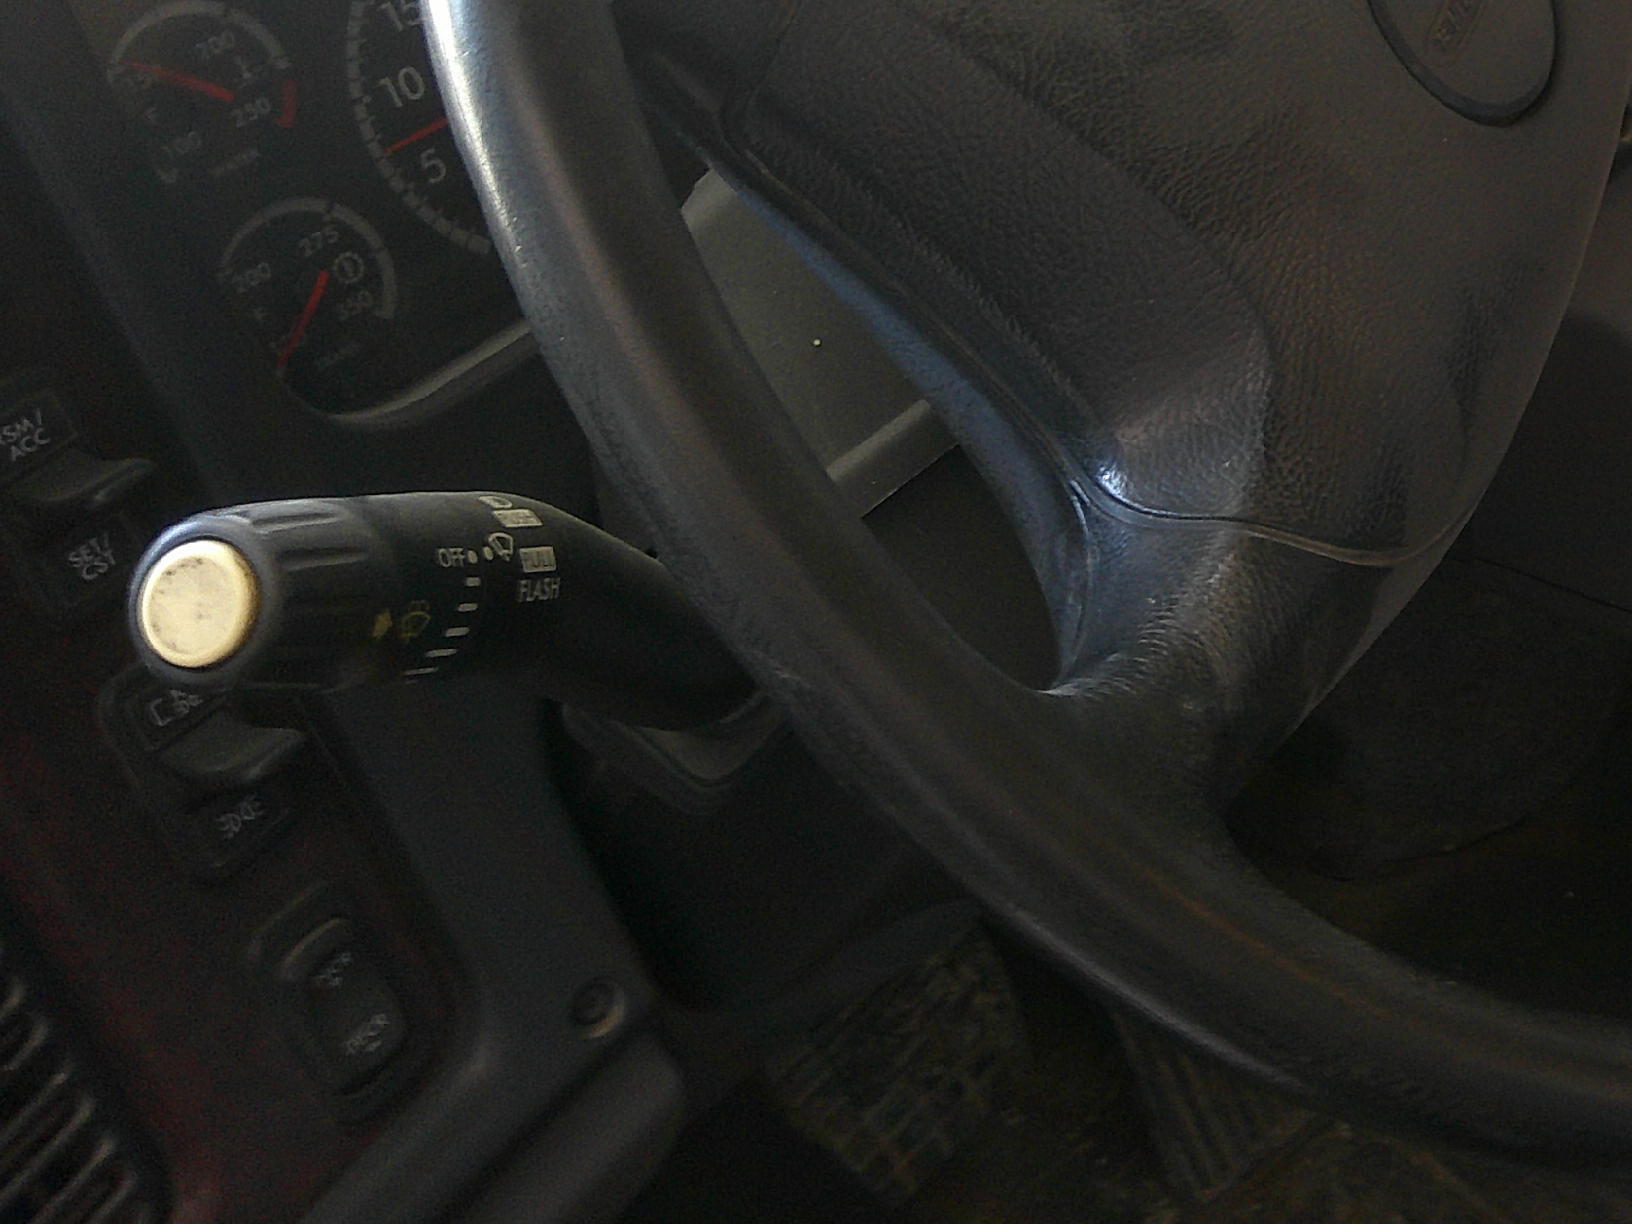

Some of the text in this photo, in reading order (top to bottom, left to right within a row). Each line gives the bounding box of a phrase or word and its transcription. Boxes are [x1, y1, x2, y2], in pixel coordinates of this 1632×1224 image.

[376, 65, 426, 108] 10
[419, 148, 447, 184] 5
[0, 407, 44, 446] SM/
[9, 426, 51, 463] ACC
[437, 547, 465, 568] OFF
[517, 576, 562, 603] FLASH
